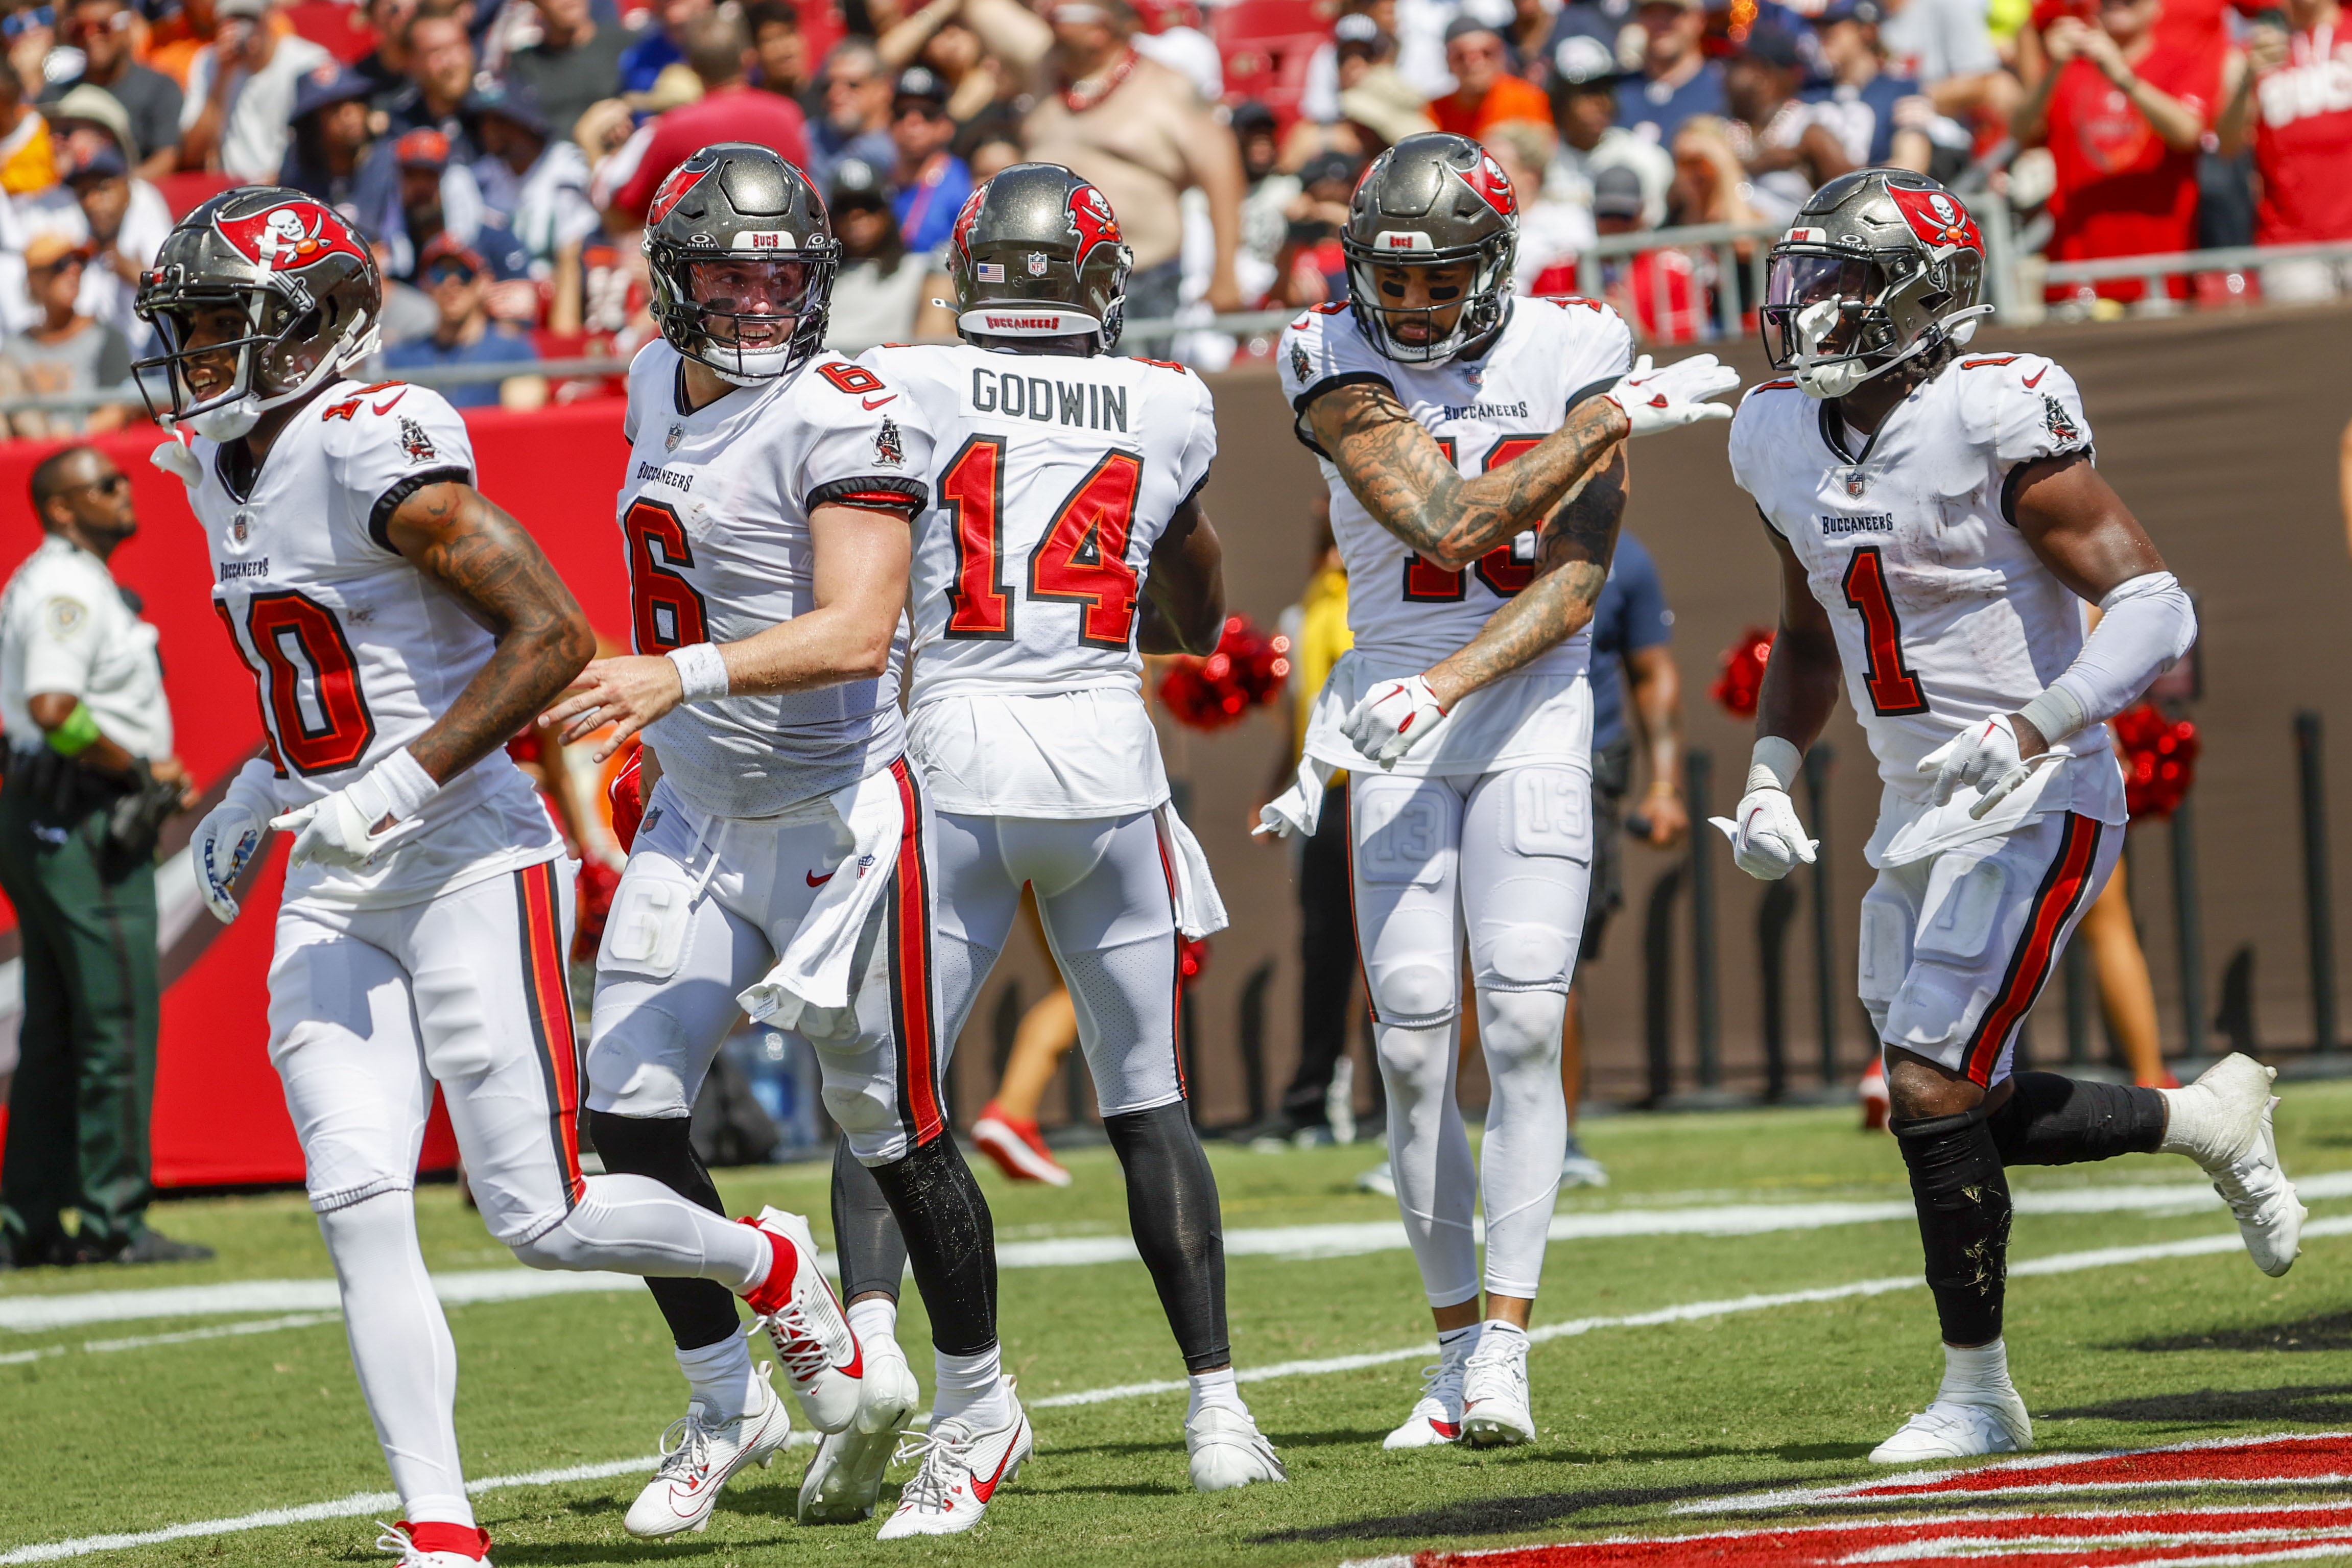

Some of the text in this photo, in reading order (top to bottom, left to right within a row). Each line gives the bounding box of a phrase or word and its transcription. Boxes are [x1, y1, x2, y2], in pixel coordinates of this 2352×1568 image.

[753, 233, 778, 247] BUCS
[1031, 263, 1045, 272] NFL
[985, 315, 1060, 331] BUCCANEERS
[814, 361, 887, 394] 6
[972, 367, 1127, 433] GODWIN
[1444, 400, 1528, 422] BUCCANEERS
[667, 435, 677, 447] NFL
[637, 461, 694, 493] BUCCANEERS
[1848, 482, 1863, 494] NFL
[1821, 512, 1893, 535] BUCCANEERS
[936, 433, 1145, 653] 14
[220, 557, 269, 582] BUCCANEERS
[624, 495, 711, 656] 6
[1841, 545, 1931, 717] 1
[1529, 776, 1585, 839] 13
[1374, 800, 1438, 861] 13
[610, 879, 671, 961] 6
